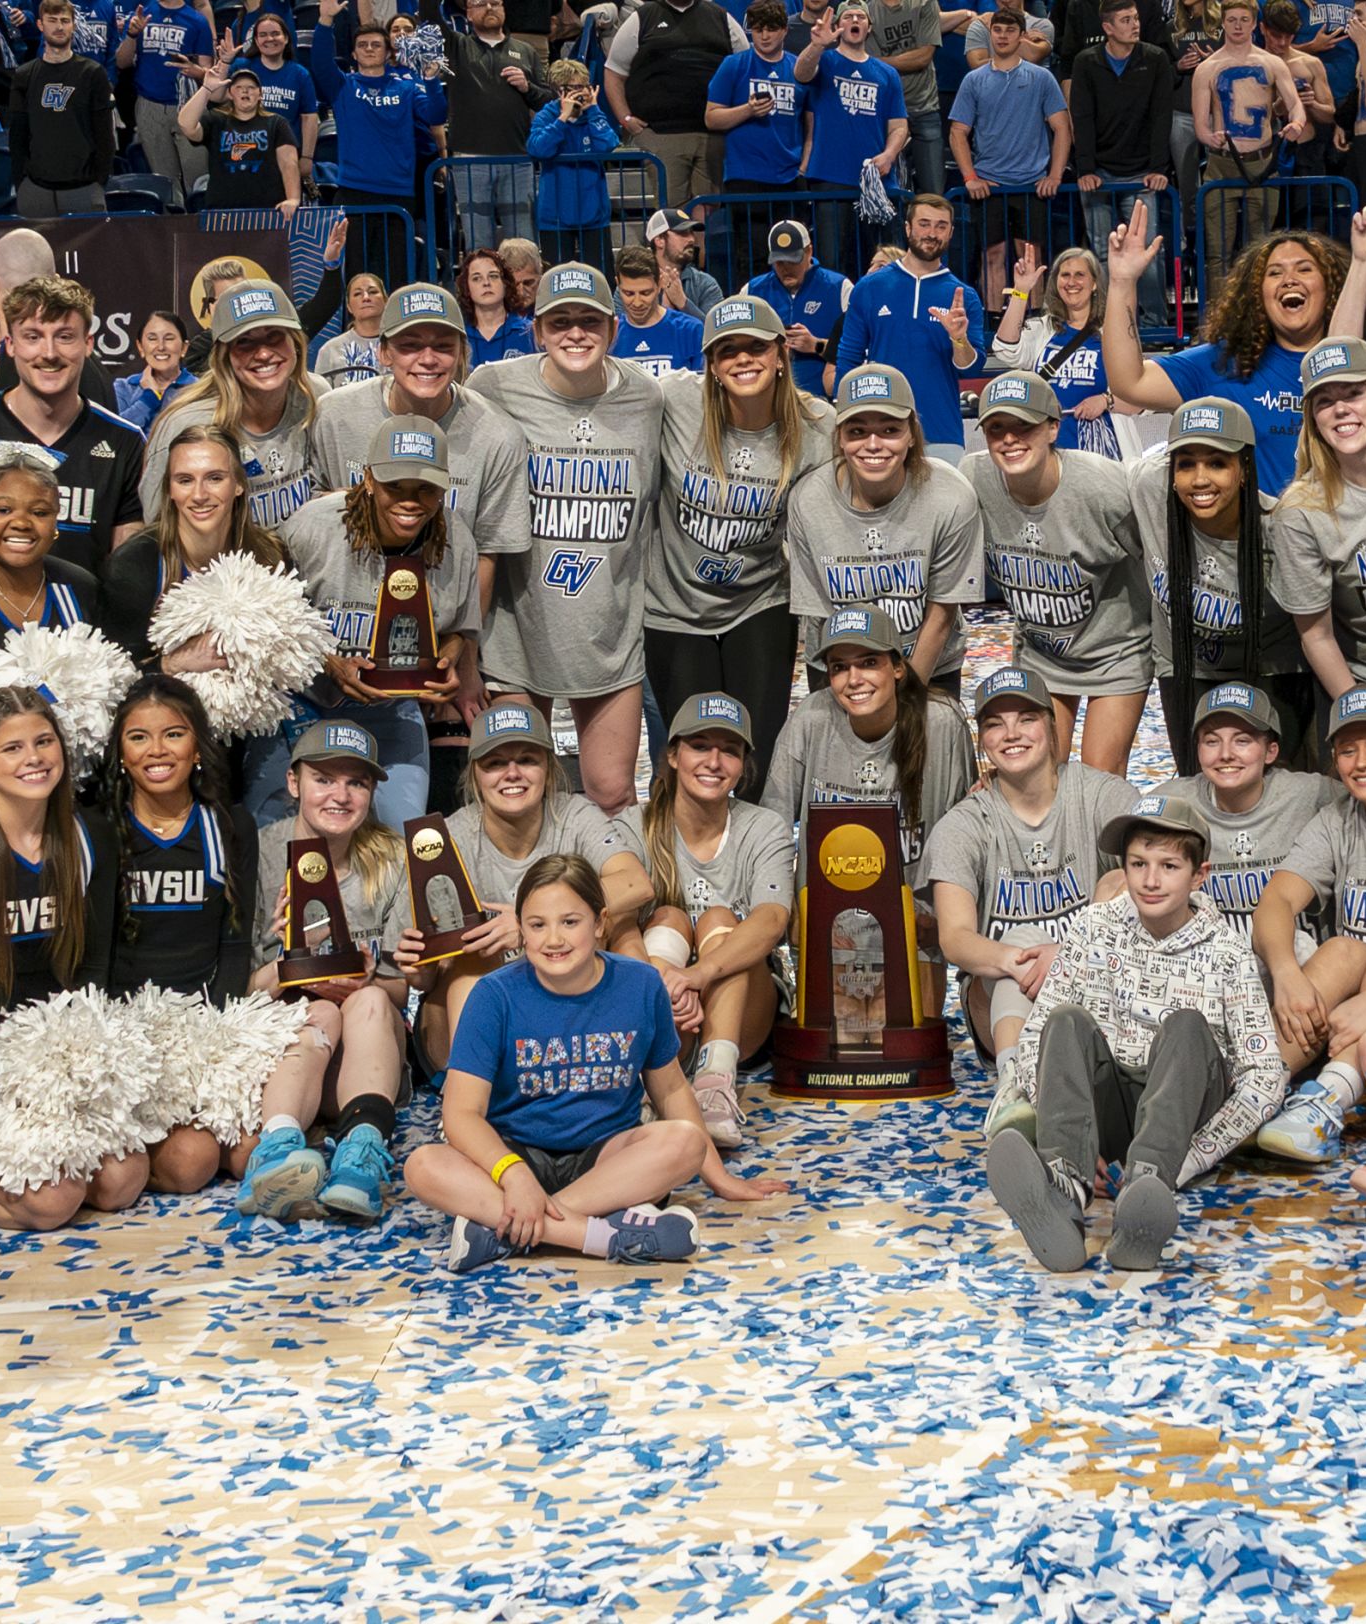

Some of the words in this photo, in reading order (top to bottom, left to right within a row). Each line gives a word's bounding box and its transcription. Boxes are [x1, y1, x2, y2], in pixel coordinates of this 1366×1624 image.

[143, 26, 186, 45] LAKER
[41, 83, 77, 112] GV
[271, 86, 296, 98] VALLEY
[834, 79, 878, 103] AKER
[261, 93, 282, 103] STATE
[1217, 65, 1269, 139] G
[220, 129, 268, 153] LAKERS
[560, 271, 590, 281] NATIONAL
[559, 280, 592, 291] CHAMPIONS
[239, 291, 272, 303] NATIONAL
[410, 292, 443, 303] NATIONAL
[241, 300, 275, 315] CHAMPIONS
[410, 301, 443, 313] CHAMPIONS
[721, 303, 751, 314] NATIONAL
[721, 311, 752, 324] CHAMPIONS
[1038, 346, 1099, 369] LKER
[1315, 346, 1344, 361] NATIONAL
[1316, 356, 1347, 372] CHAMPIONS
[857, 376, 888, 387] NATIONAL
[996, 380, 1026, 391] NATIONAL
[857, 385, 888, 396] CHAMPIONS
[995, 389, 1027, 400] CHAMPIONS
[1190, 408, 1219, 419] NATIONAL
[1189, 417, 1219, 429] CHAMPIONS
[402, 433, 432, 446] NATIONAL
[400, 443, 434, 457] CHAMPIONS
[528, 454, 635, 496] NATIONAL
[679, 502, 779, 553] CHAMPIONS
[543, 547, 607, 598] GV
[695, 554, 745, 586] GV
[985, 550, 1091, 594] NATIONAL
[826, 559, 928, 600] NATIONAL
[836, 612, 866, 622] NATIONAL
[835, 620, 867, 633] CHAMPIONS
[993, 671, 1022, 682] NATIONAL
[1218, 687, 1249, 699] NATIONAL
[1217, 696, 1248, 709] CHAMPIONS
[495, 709, 528, 720] NATIONAL
[495, 718, 529, 732] CHAMPIONS
[416, 841, 443, 856] NCAA
[826, 856, 883, 875] NCAA
[5, 896, 56, 935] GVS
[1120, 938, 1128, 950] 18
[1072, 951, 1082, 963] 18
[1087, 970, 1095, 980] 18
[1150, 963, 1160, 974] 26
[1115, 988, 1133, 1001] A&F
[516, 1030, 638, 1068] DAIRY
[1250, 1038, 1262, 1050] 92
[517, 1063, 634, 1098] QUEEN
[807, 1072, 854, 1086] NATIONAL
[856, 1072, 911, 1086] CHAMPION
